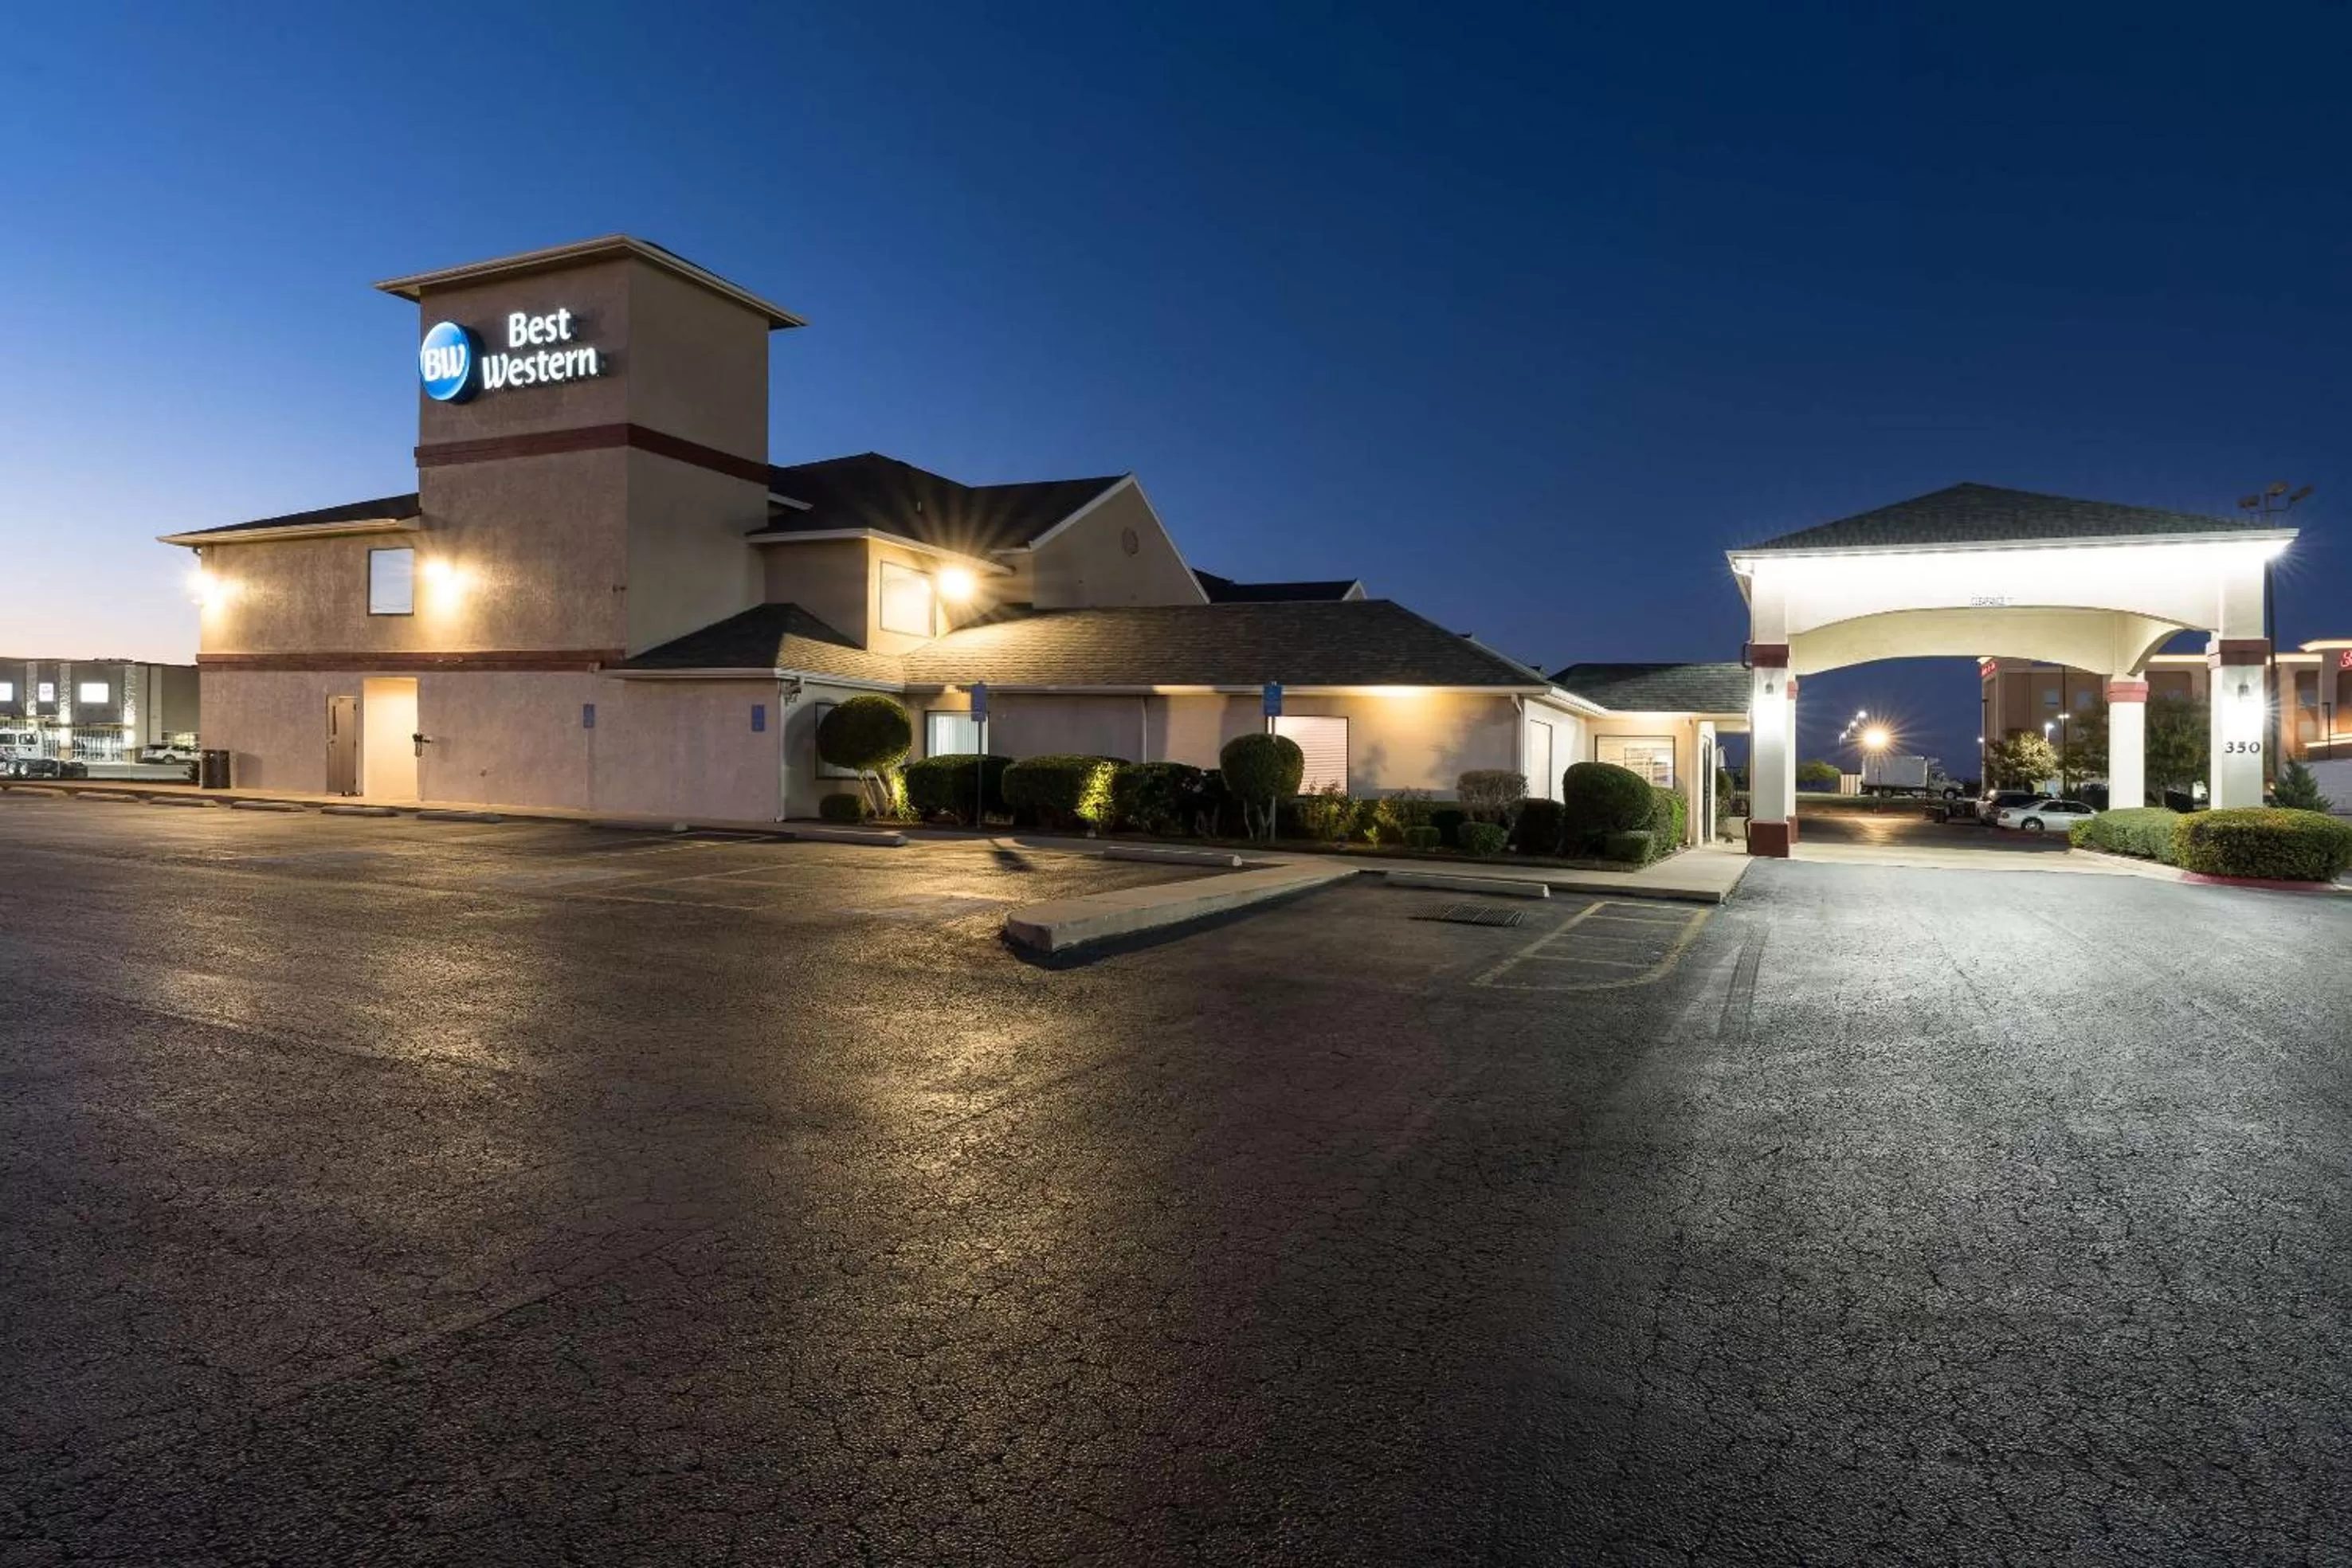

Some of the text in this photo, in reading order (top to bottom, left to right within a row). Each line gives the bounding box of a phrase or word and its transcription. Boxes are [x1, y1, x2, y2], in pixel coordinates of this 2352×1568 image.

[508, 308, 571, 348] Best
[423, 344, 466, 382] BW
[481, 347, 598, 390] Western
[2225, 741, 2260, 753] 350
